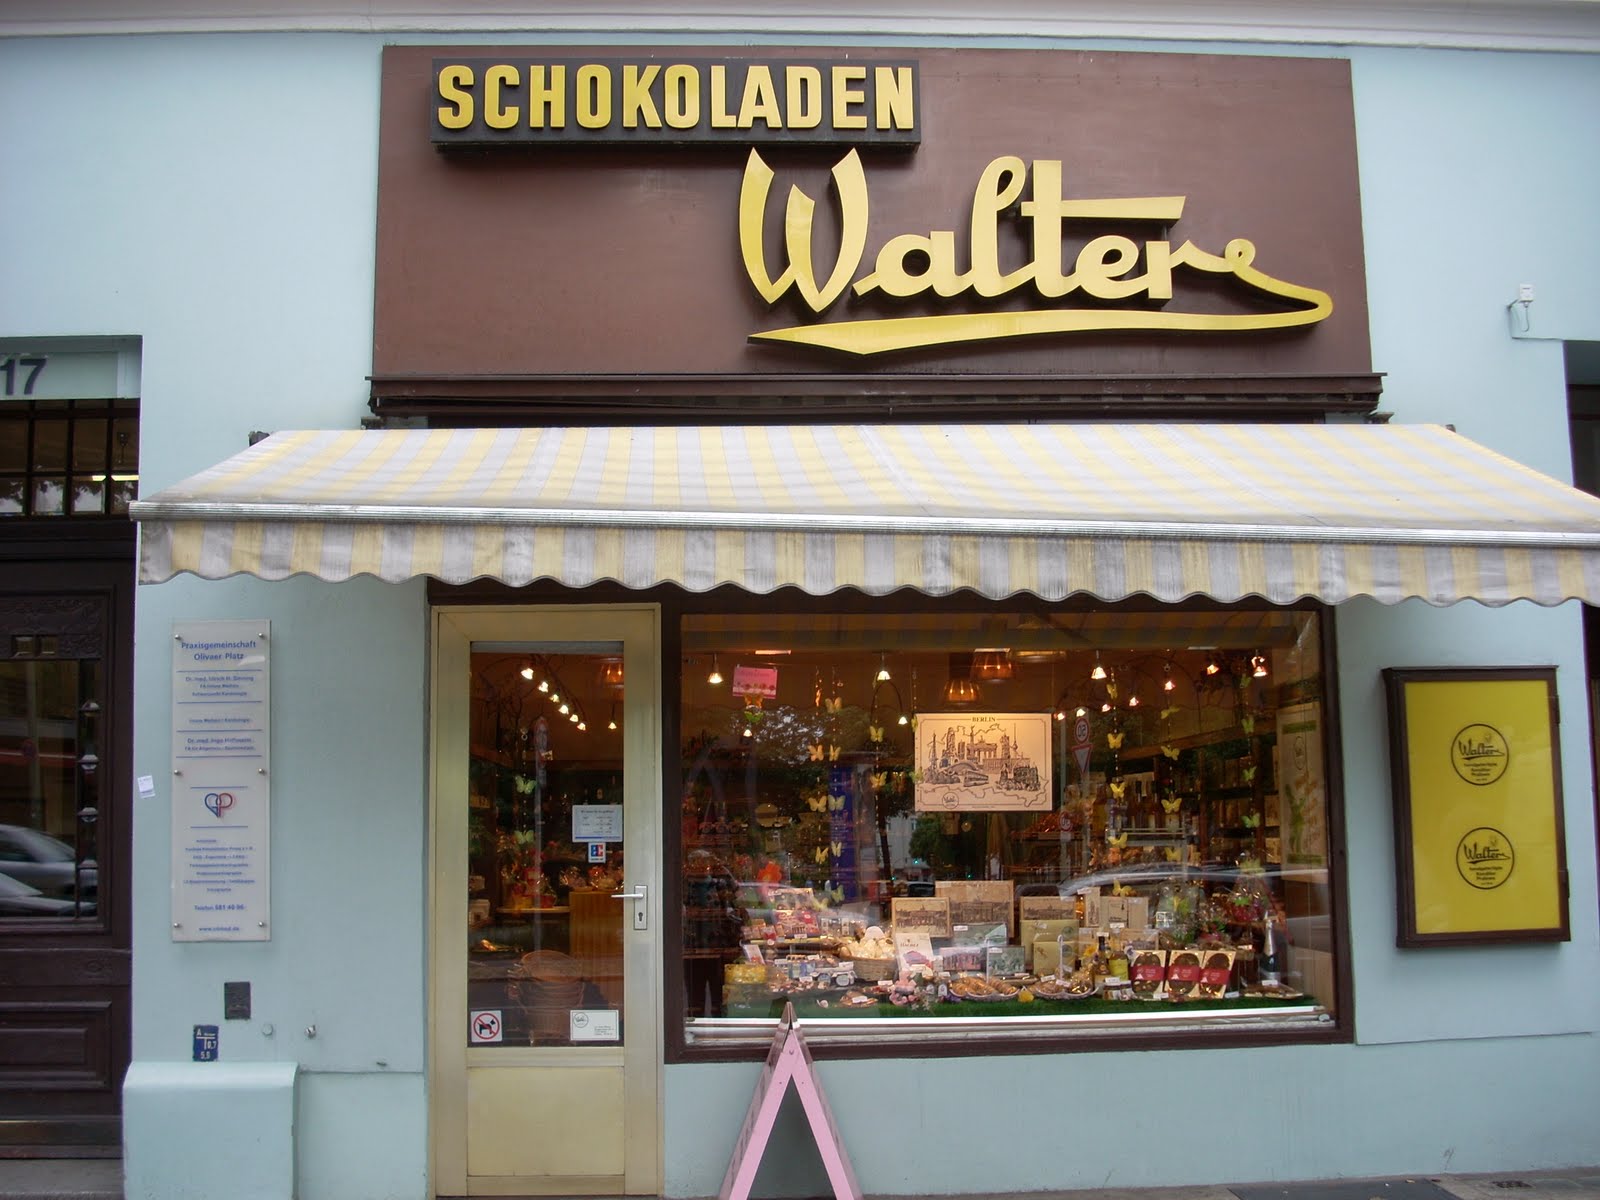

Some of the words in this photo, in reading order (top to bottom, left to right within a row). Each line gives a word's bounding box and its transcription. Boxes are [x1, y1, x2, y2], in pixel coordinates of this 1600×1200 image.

[438, 64, 914, 130] SCHOKOLADEN
[739, 147, 1333, 355] Walter
[0, 358, 47, 395] 17
[181, 640, 256, 650] Praxisgemeinschaft
[193, 652, 222, 661] Olivaer
[225, 652, 244, 660] Platz
[1458, 738, 1505, 760] Walter
[1463, 842, 1511, 864] Walter
[196, 1028, 202, 1036] A
